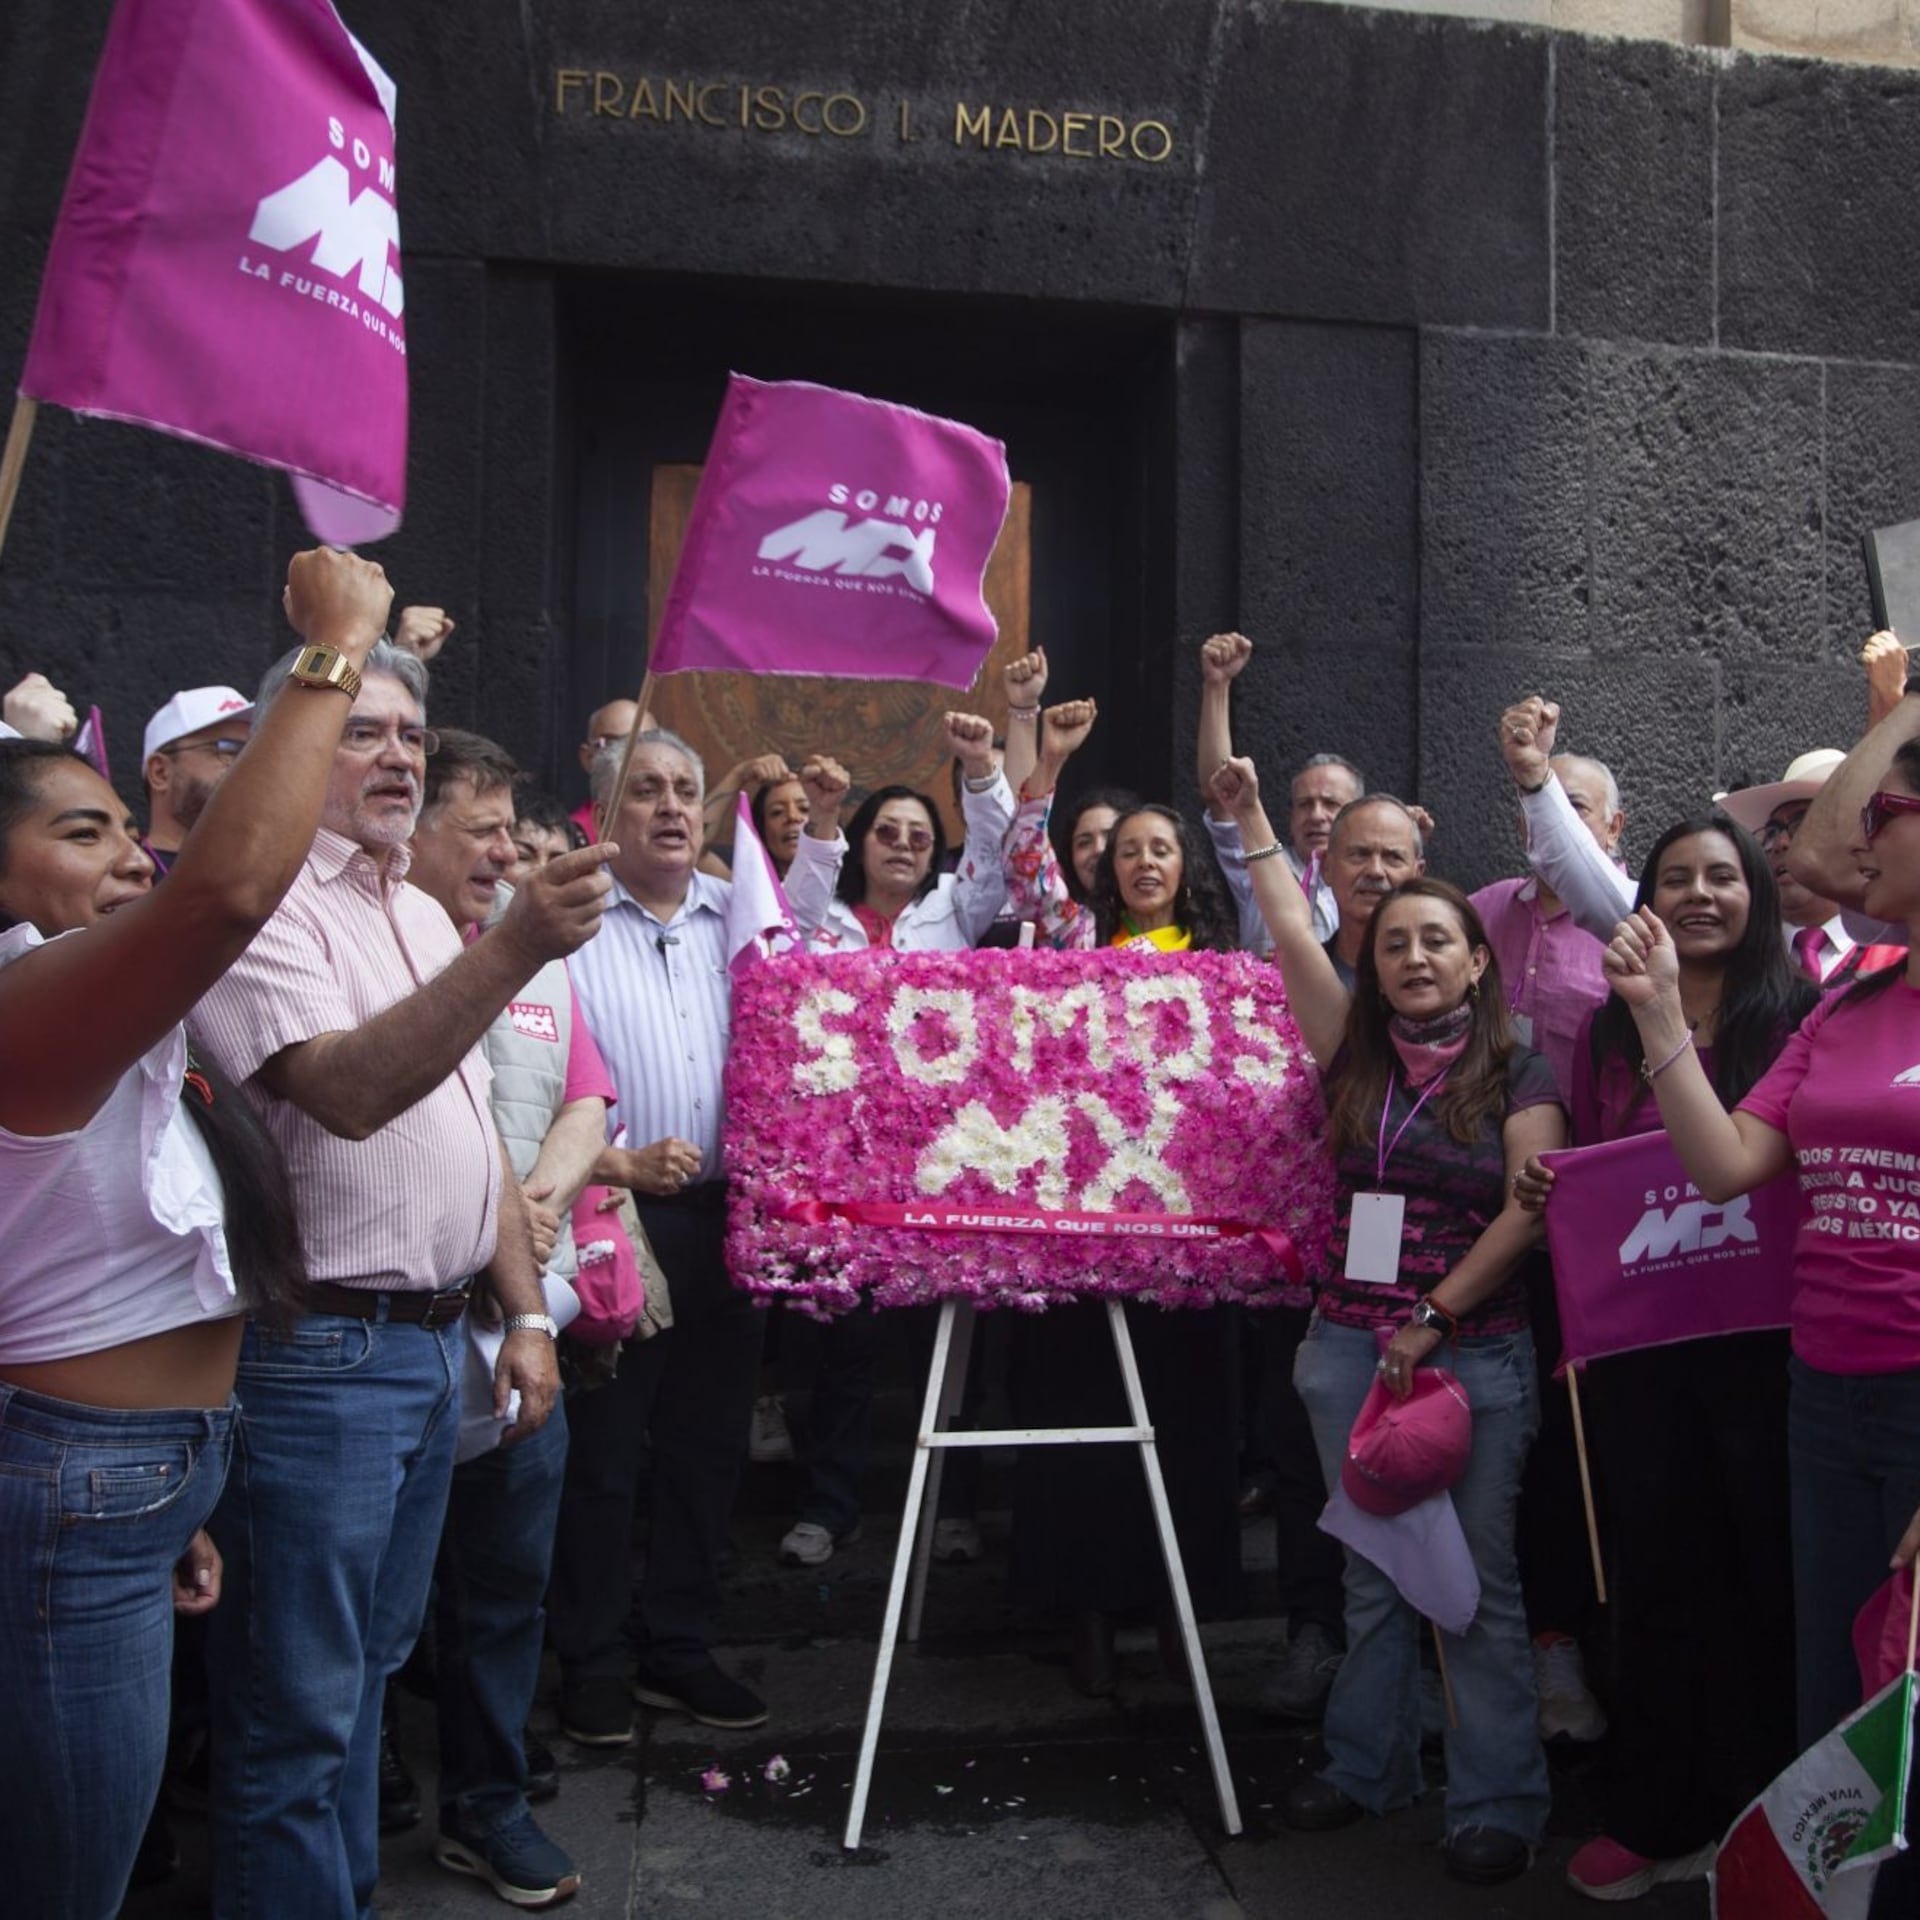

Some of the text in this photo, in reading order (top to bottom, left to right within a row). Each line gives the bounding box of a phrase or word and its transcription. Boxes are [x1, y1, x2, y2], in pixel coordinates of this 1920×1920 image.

[556, 69, 866, 136] FRANCISCO
[955, 101, 1173, 162] MADERO
[238, 256, 271, 281] LA
[280, 271, 359, 319] FUERZA
[362, 310, 386, 338] QUE
[828, 483, 944, 524] SOMOS
[752, 565, 771, 577] LA
[834, 578, 865, 592] QUE
[793, 973, 1291, 1098] SOMOS
[914, 1091, 1196, 1216] MX
[1796, 1147, 1834, 1167] DOS
[1846, 1171, 1866, 1189] A
[904, 1212, 1221, 1237] LA FUERZA QUE NOS UNE
[1623, 1246, 1761, 1278] LA FUERZA QUE NOS UNE
[1792, 1787, 1864, 1842] VIVA MEXICO
